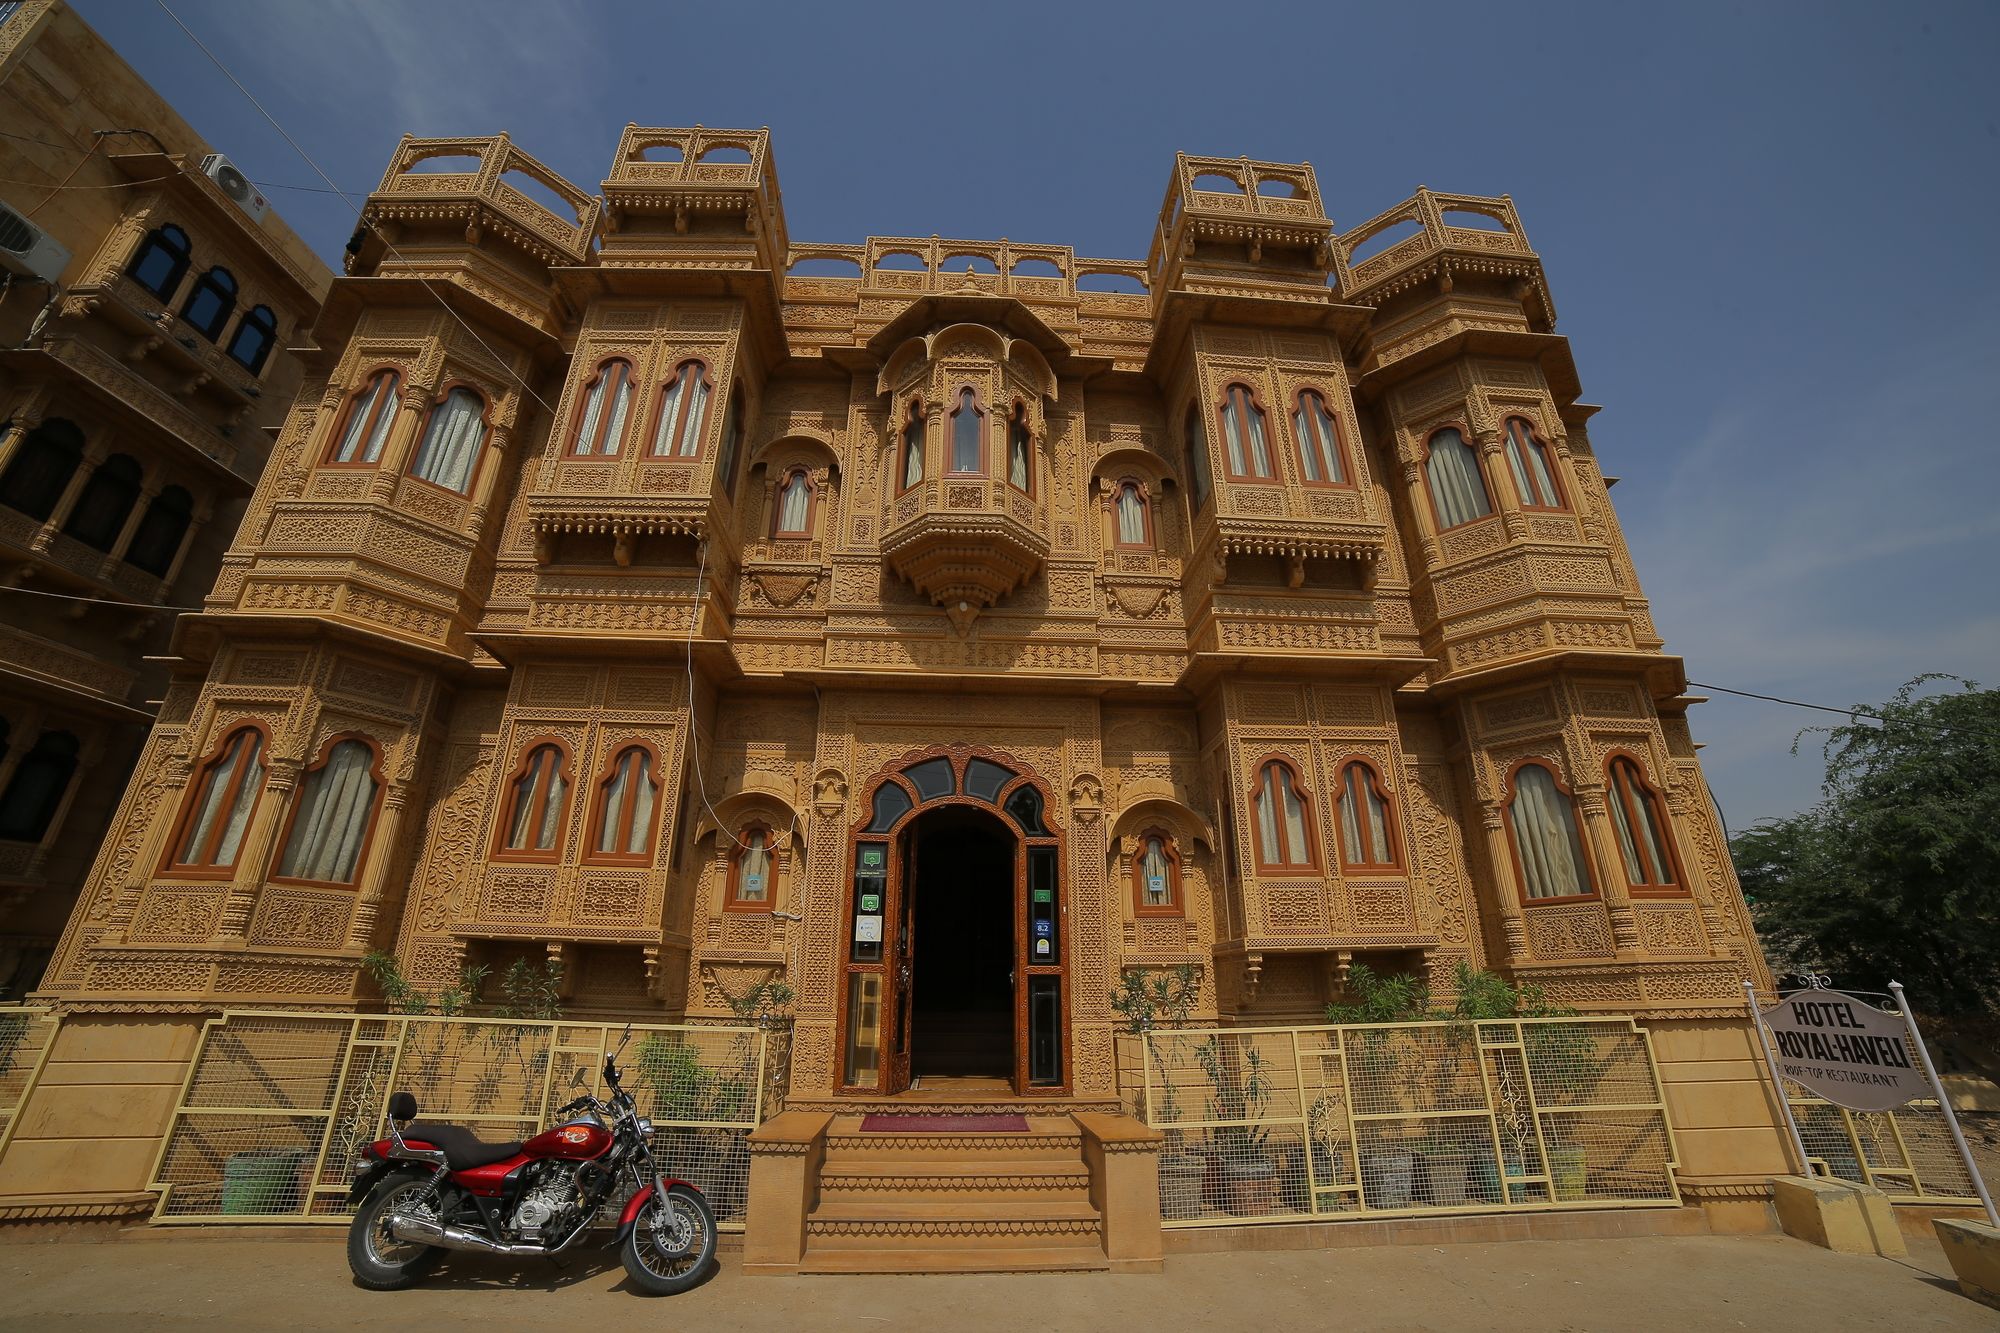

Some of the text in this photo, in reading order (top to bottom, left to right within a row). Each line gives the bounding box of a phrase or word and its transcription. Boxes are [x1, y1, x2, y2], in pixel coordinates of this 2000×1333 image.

[1791, 1002, 1865, 1029] HOTEL
[1775, 1031, 1911, 1068] ROYAL-HAVELI
[1784, 1064, 1900, 1088] ROOF-TOP RESTAURANT
